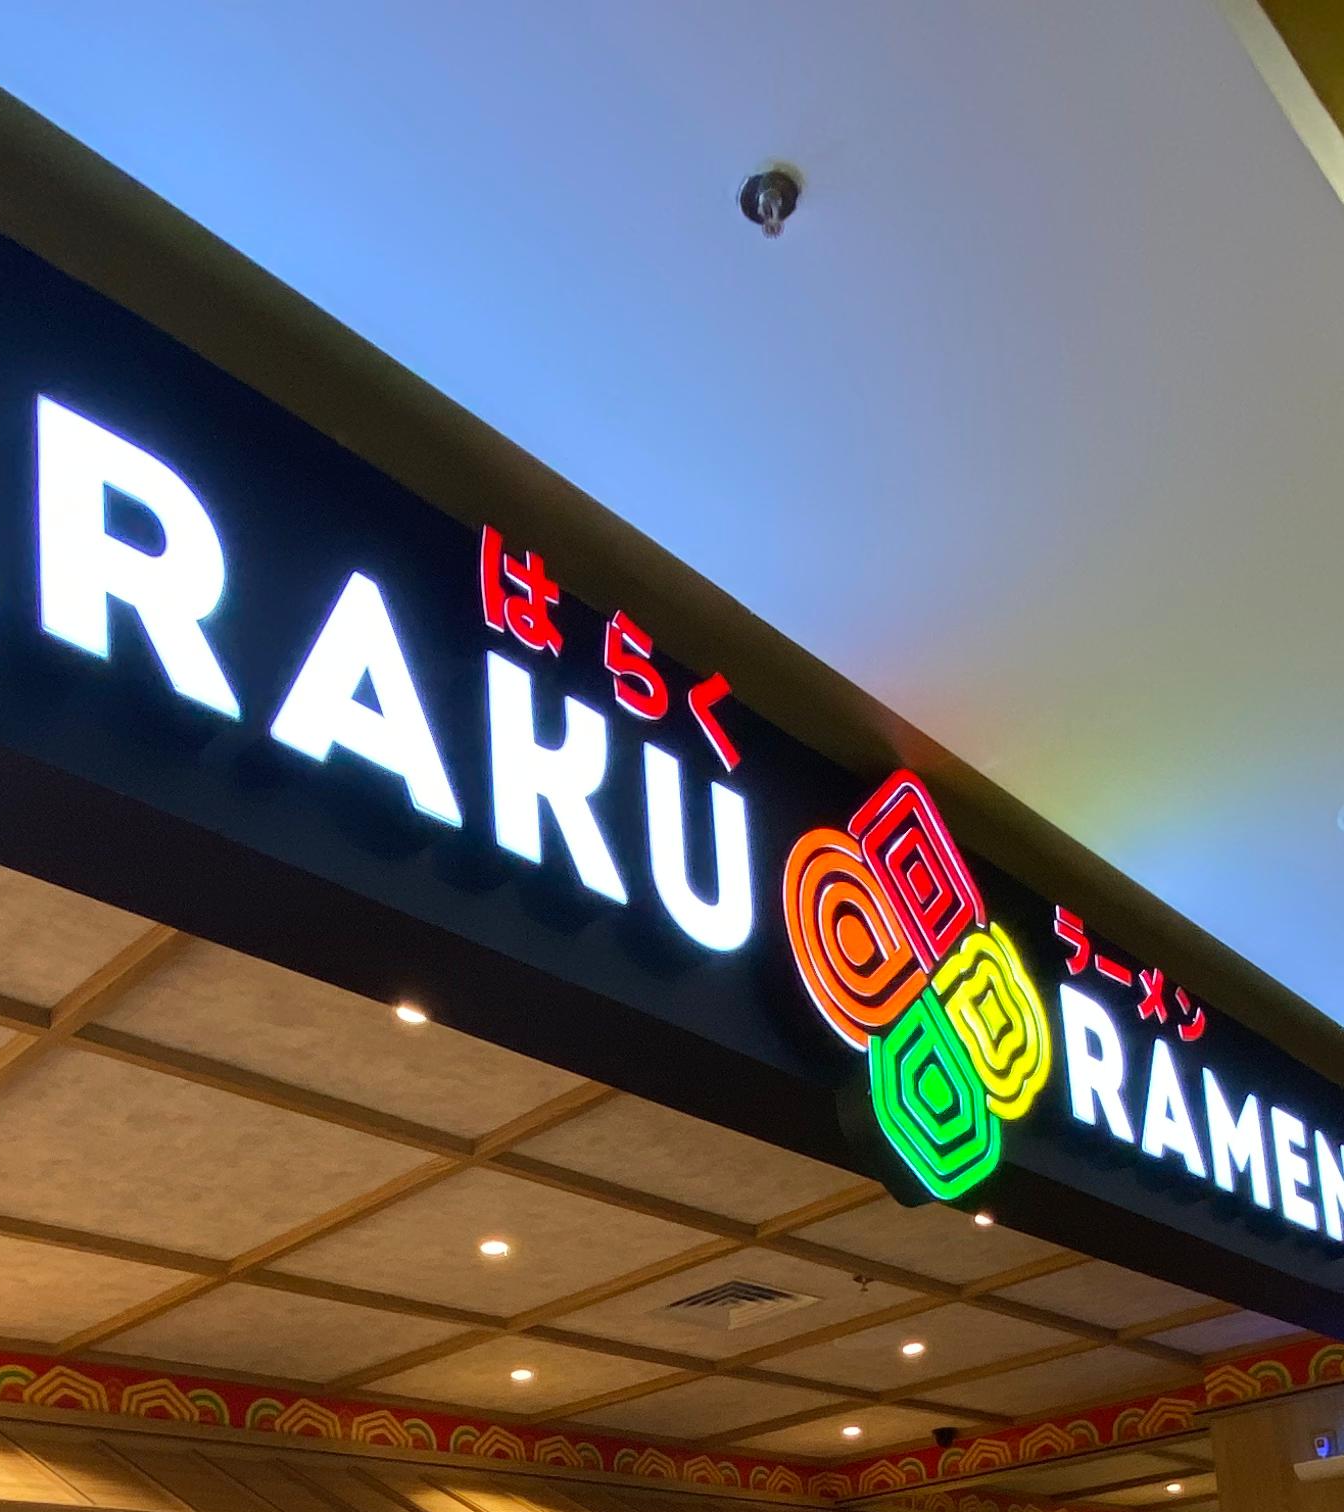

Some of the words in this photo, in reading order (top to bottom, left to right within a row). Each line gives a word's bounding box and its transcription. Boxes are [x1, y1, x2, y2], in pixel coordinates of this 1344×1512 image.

[478, 524, 741, 772] はらく
[1054, 903, 1206, 1041] ラーメン
